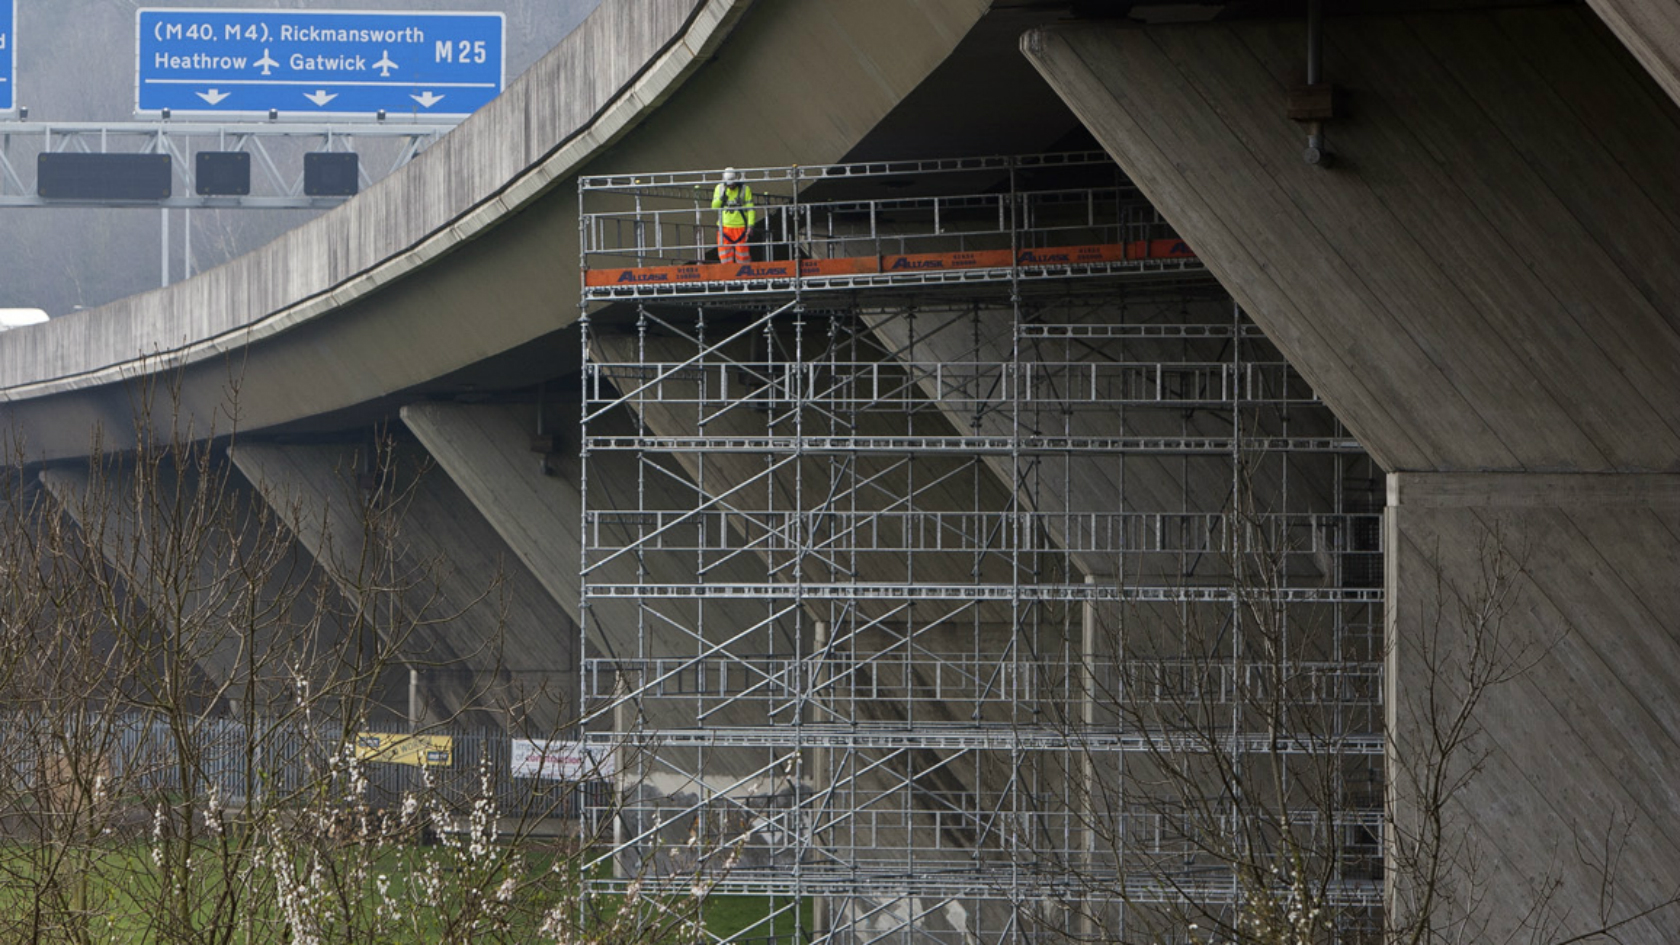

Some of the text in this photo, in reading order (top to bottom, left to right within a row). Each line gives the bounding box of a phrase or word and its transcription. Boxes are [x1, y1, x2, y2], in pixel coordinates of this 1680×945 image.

[280, 24, 425, 43] Rickmansworth
[155, 52, 247, 69] Heathrow
[435, 40, 487, 63] M25
[289, 53, 367, 71] Gatwick
